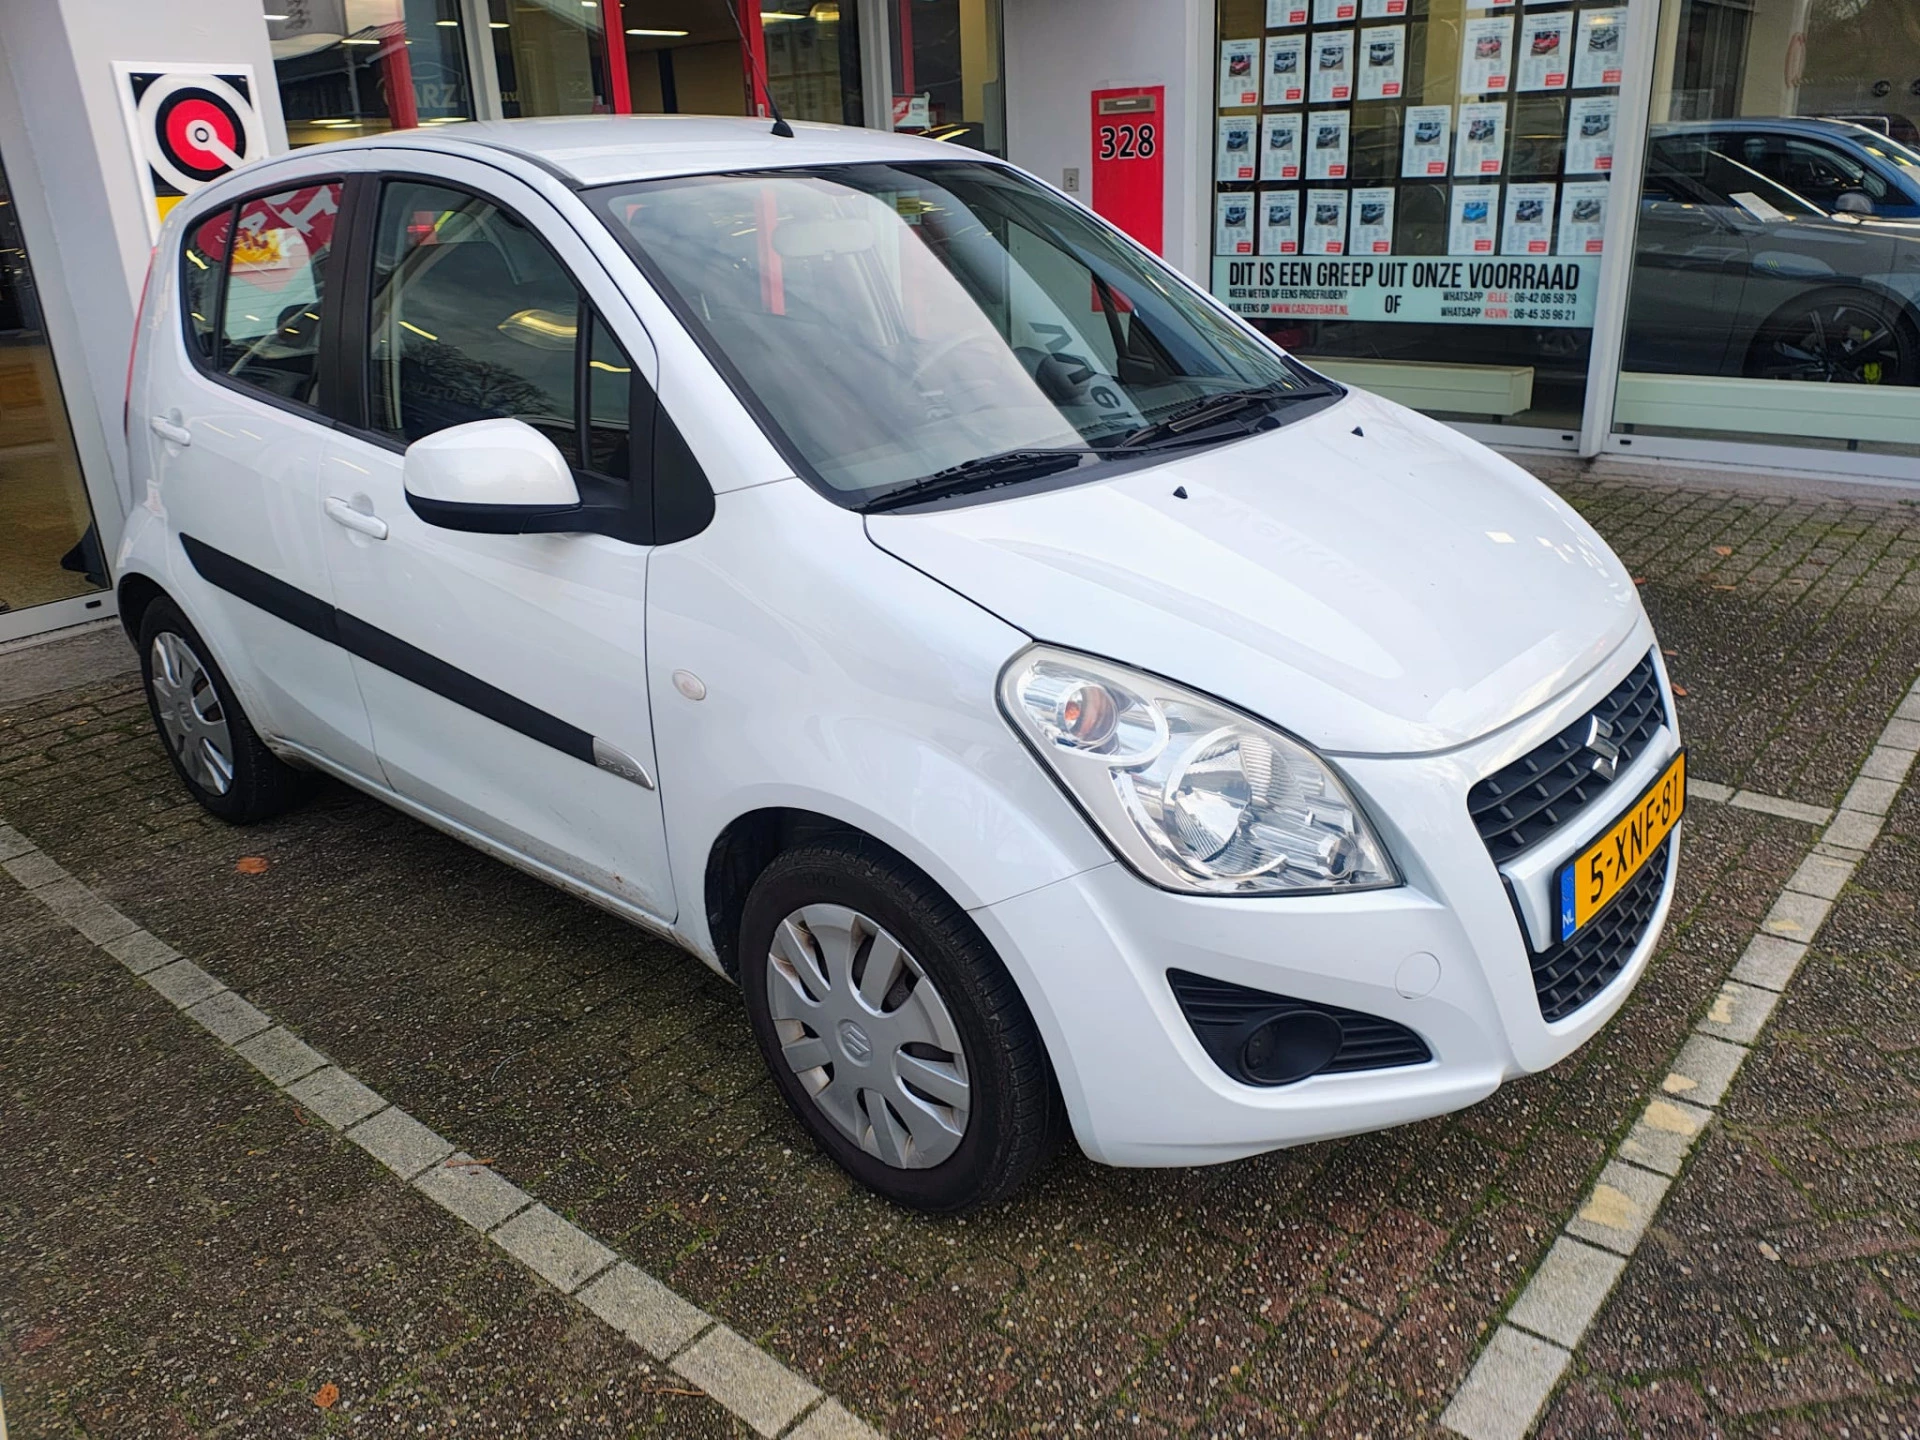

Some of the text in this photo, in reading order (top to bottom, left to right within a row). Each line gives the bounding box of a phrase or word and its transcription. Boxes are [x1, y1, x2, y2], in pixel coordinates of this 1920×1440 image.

[1099, 123, 1156, 160] 328
[1229, 262, 1580, 291] DIT IS EEN GREEP UIT ONZE VOORRAAD
[1229, 288, 1247, 298] MEER
[1248, 289, 1271, 299] WETEN
[1272, 289, 1280, 299] OF
[1281, 289, 1298, 299] EENS
[1443, 291, 1483, 303] WHATSAPP
[1486, 292, 1509, 303] JELLE
[1514, 292, 1540, 304] 06-42
[1540, 293, 1552, 304] 06
[1553, 293, 1564, 304] 58
[1565, 293, 1577, 305] 79
[1243, 303, 1260, 313] EENS
[1261, 303, 1270, 313] OP
[1384, 294, 1402, 313] OF
[1441, 307, 1481, 319] WHATSAPP
[1484, 308, 1508, 319] KEVIN
[1514, 308, 1538, 320] 06-45
[1539, 309, 1551, 320] 35
[1552, 309, 1564, 320] 96
[1565, 309, 1576, 321] 21
[1590, 771, 1678, 905] 5-XNF-81
[1562, 908, 1575, 929] NL
